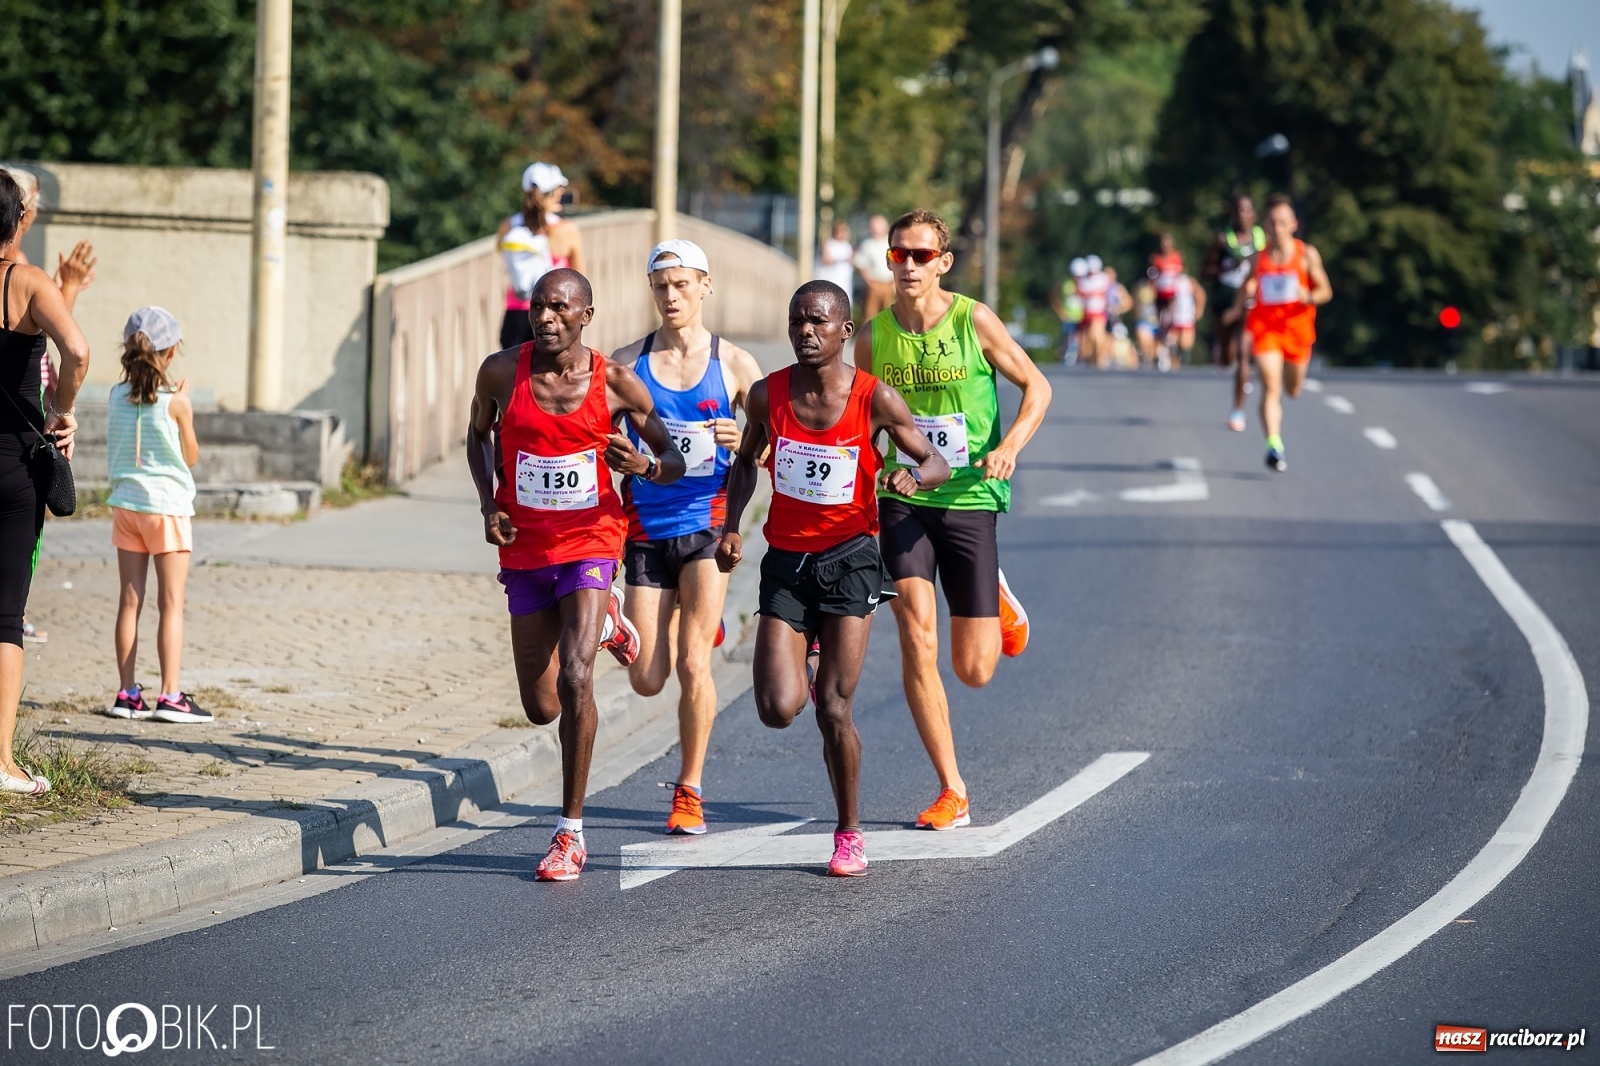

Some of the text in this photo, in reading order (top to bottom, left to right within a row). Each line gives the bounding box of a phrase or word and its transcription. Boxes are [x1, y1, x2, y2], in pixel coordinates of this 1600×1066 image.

[883, 363, 967, 387] Radlinioki
[541, 470, 579, 489] 130
[805, 460, 831, 481] 39
